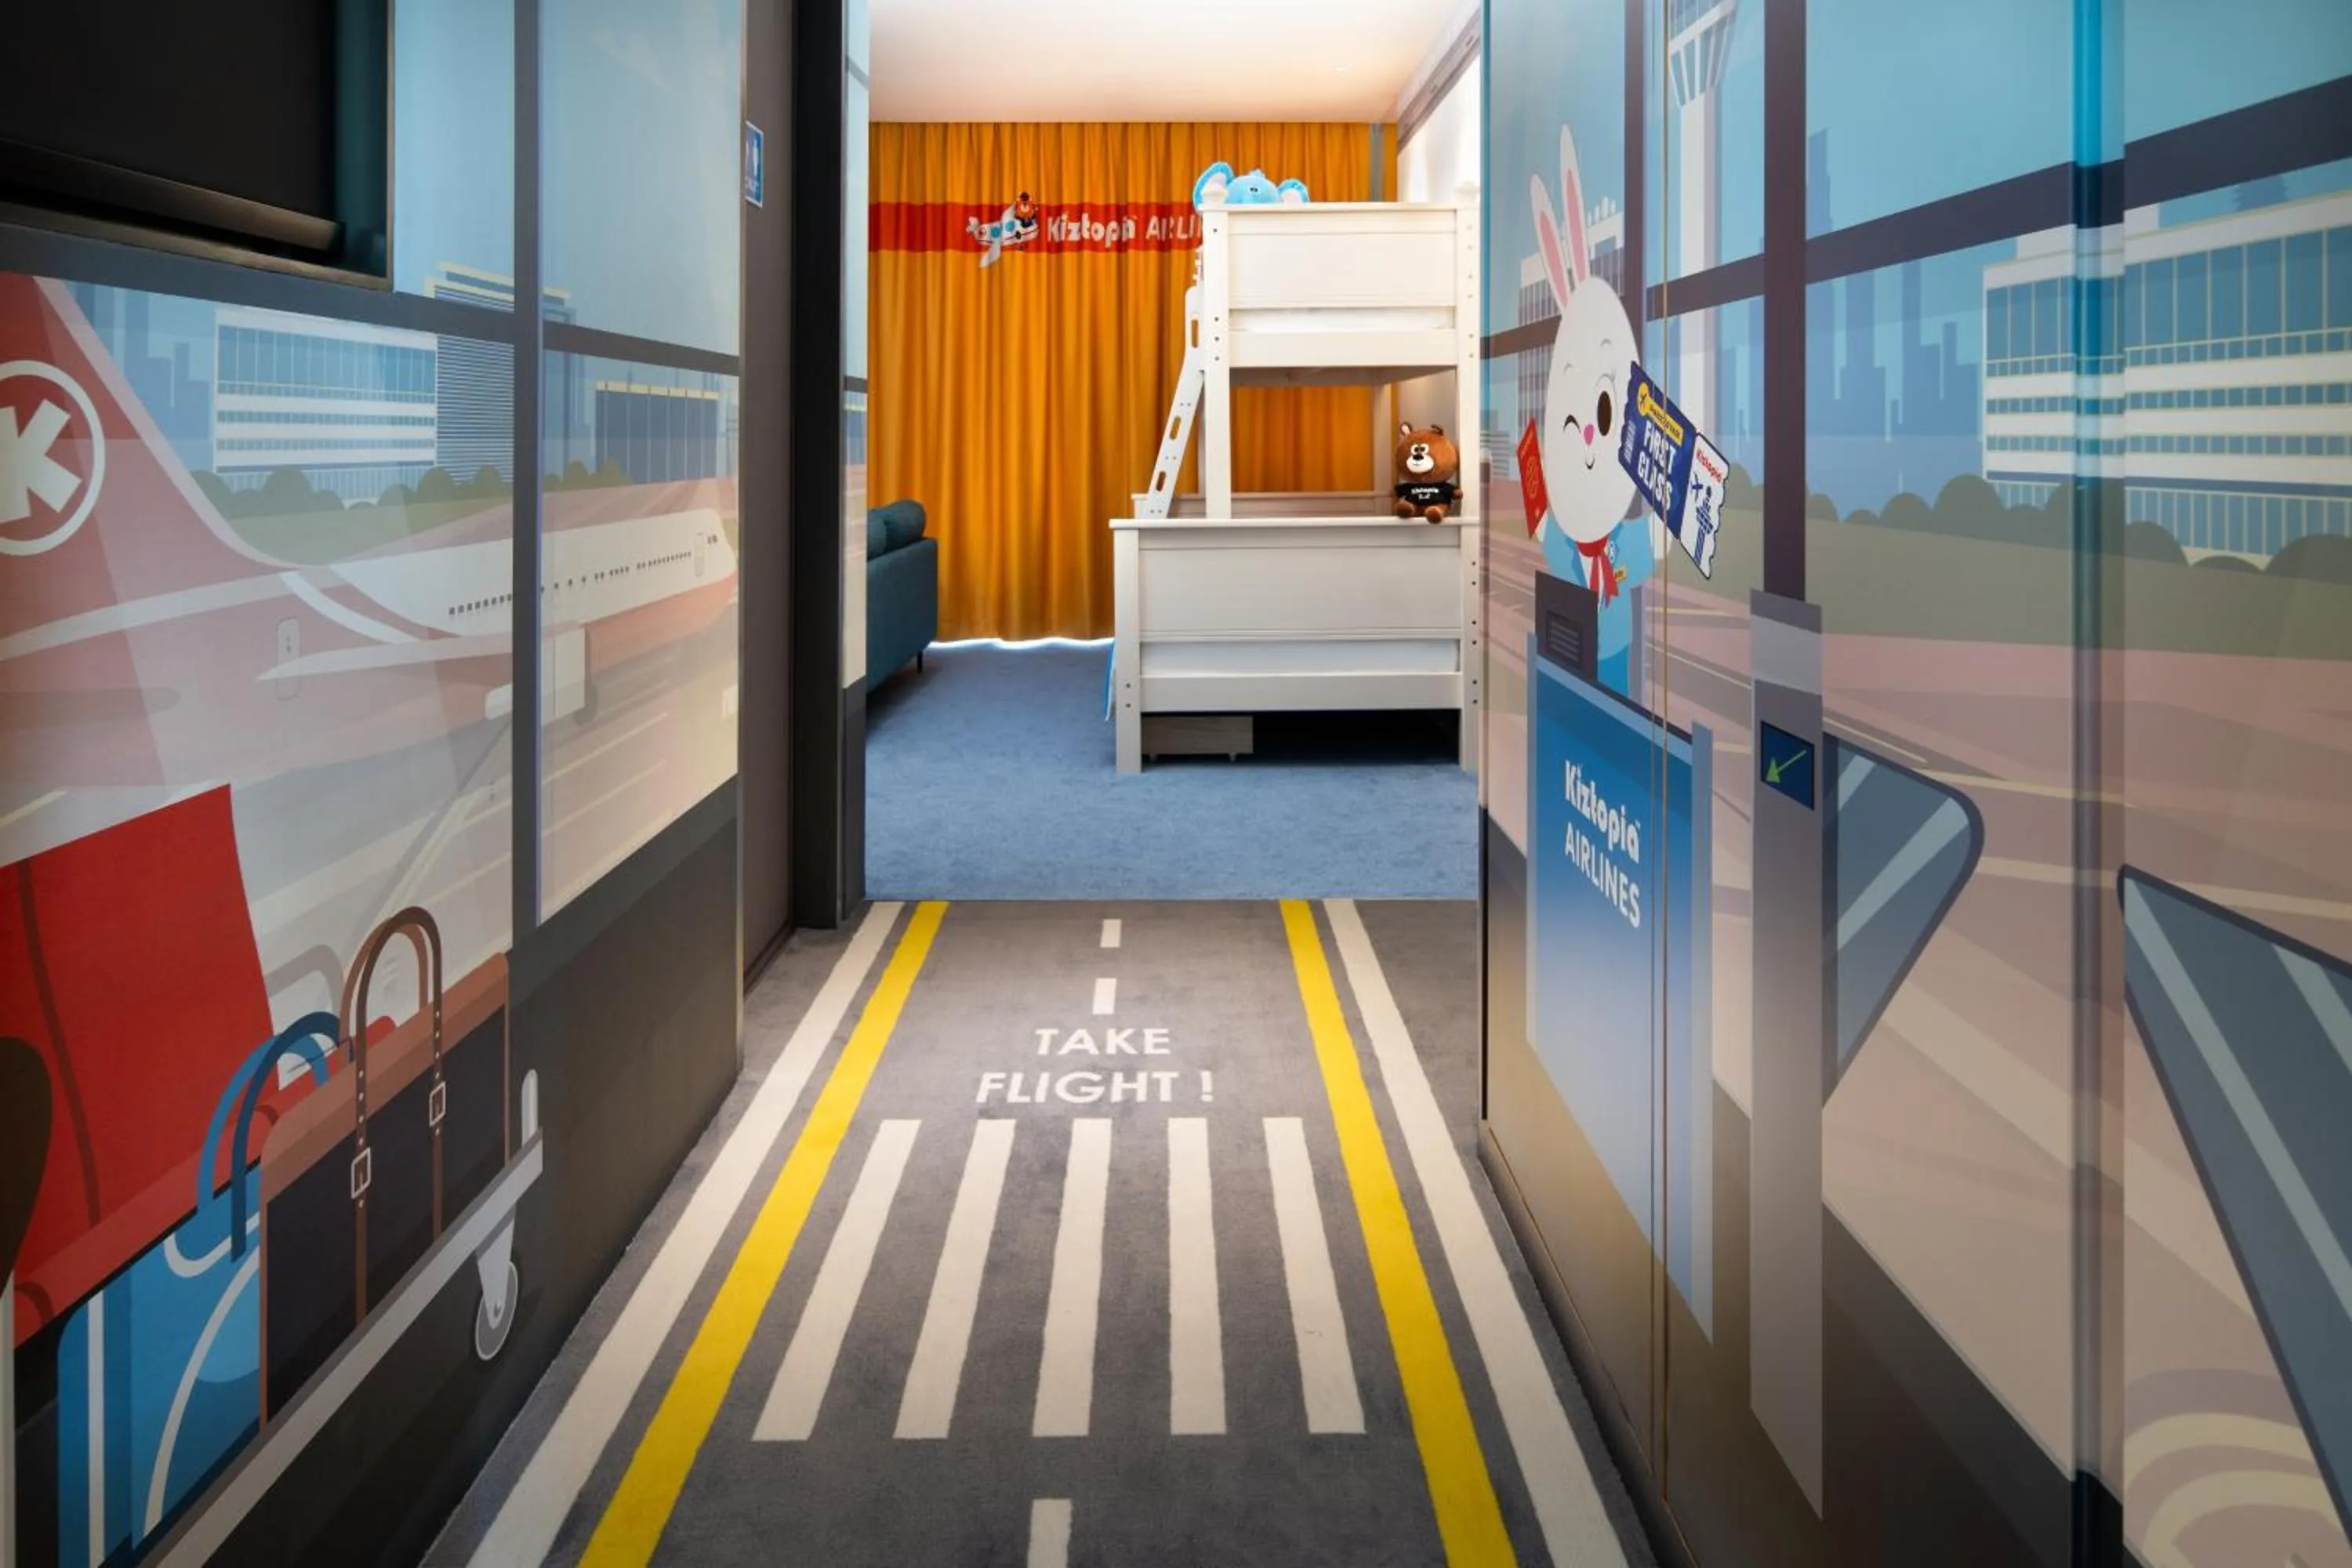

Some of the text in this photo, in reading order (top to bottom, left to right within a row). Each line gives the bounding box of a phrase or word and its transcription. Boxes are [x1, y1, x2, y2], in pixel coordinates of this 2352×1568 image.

[1145, 215, 1201, 240] AIRLI
[1644, 419, 1677, 475] FIRST
[1638, 451, 1672, 510] CLASS
[1565, 760, 1640, 863] Kiztopia
[1565, 821, 1640, 928] AIRLINES
[1035, 1028, 1171, 1055] TAKE
[976, 1071, 1179, 1103] FLIGHT
